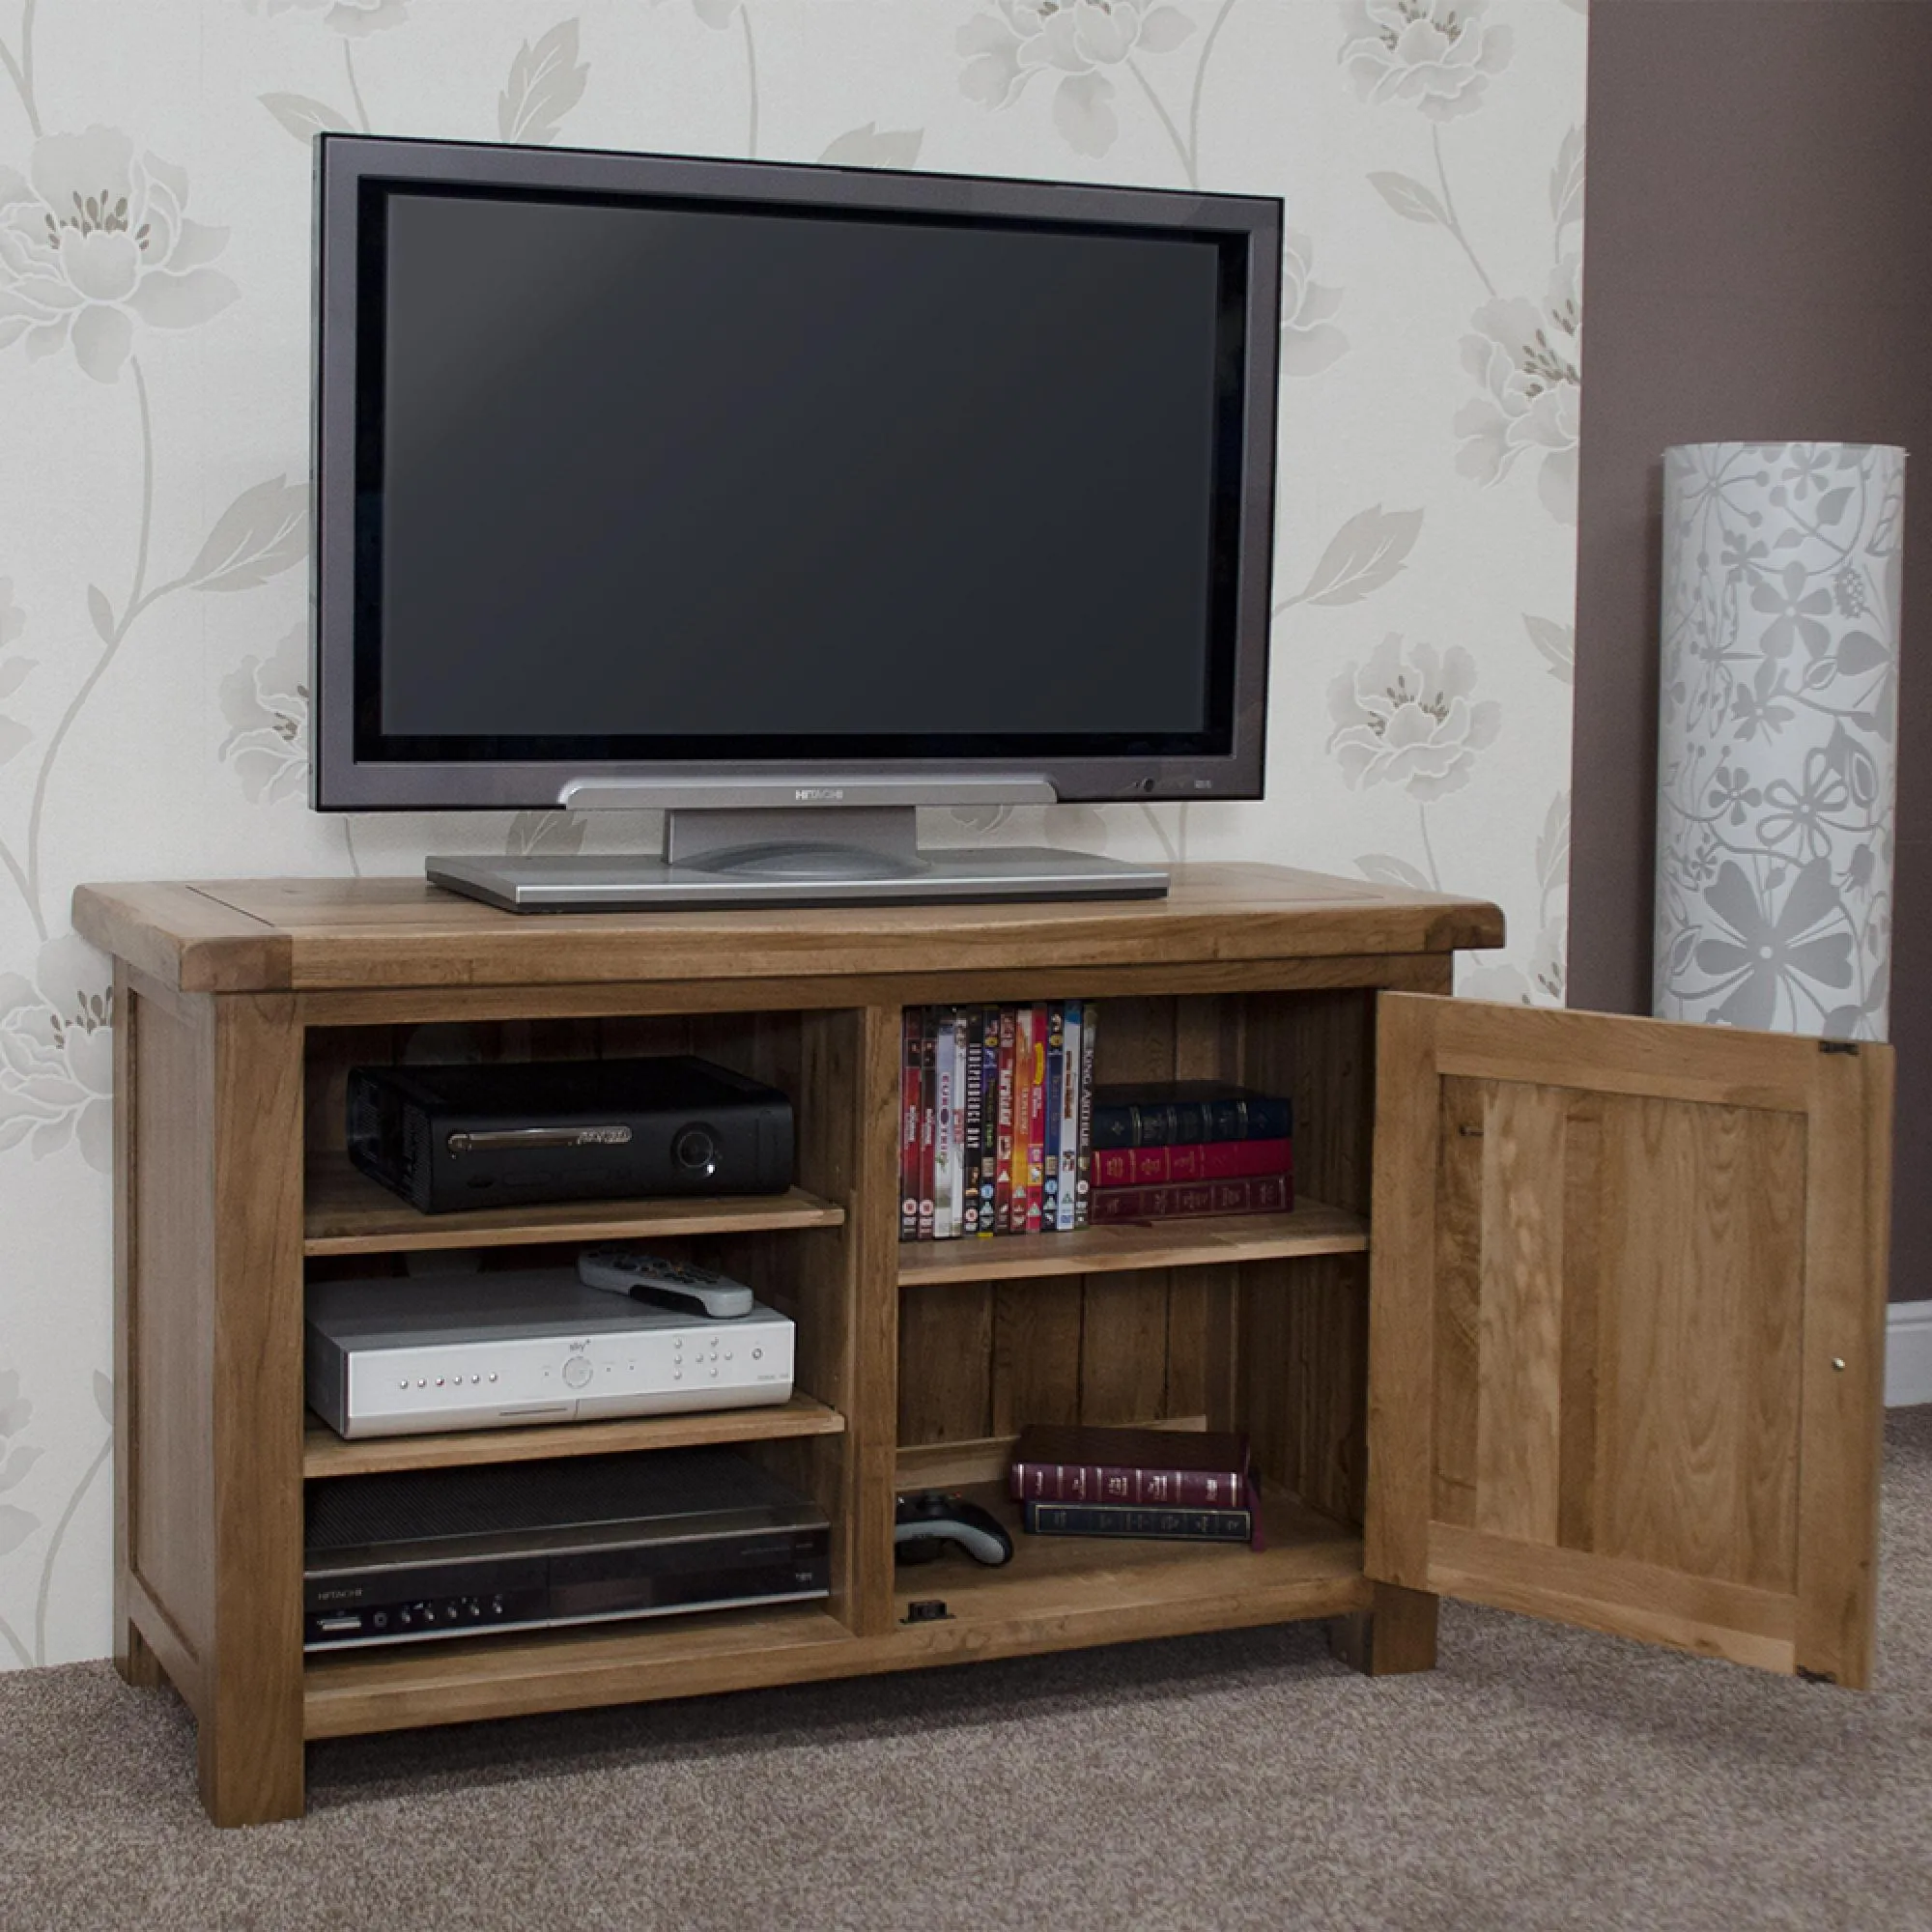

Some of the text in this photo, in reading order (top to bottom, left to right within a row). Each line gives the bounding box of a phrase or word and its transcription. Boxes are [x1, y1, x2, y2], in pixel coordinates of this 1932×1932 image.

[795, 789, 843, 801] HITACHI
[967, 1042, 981, 1124] INDEPENDENCE
[1081, 1048, 1094, 1147] KING ARTHUR
[318, 1587, 362, 1600] HITACHI
